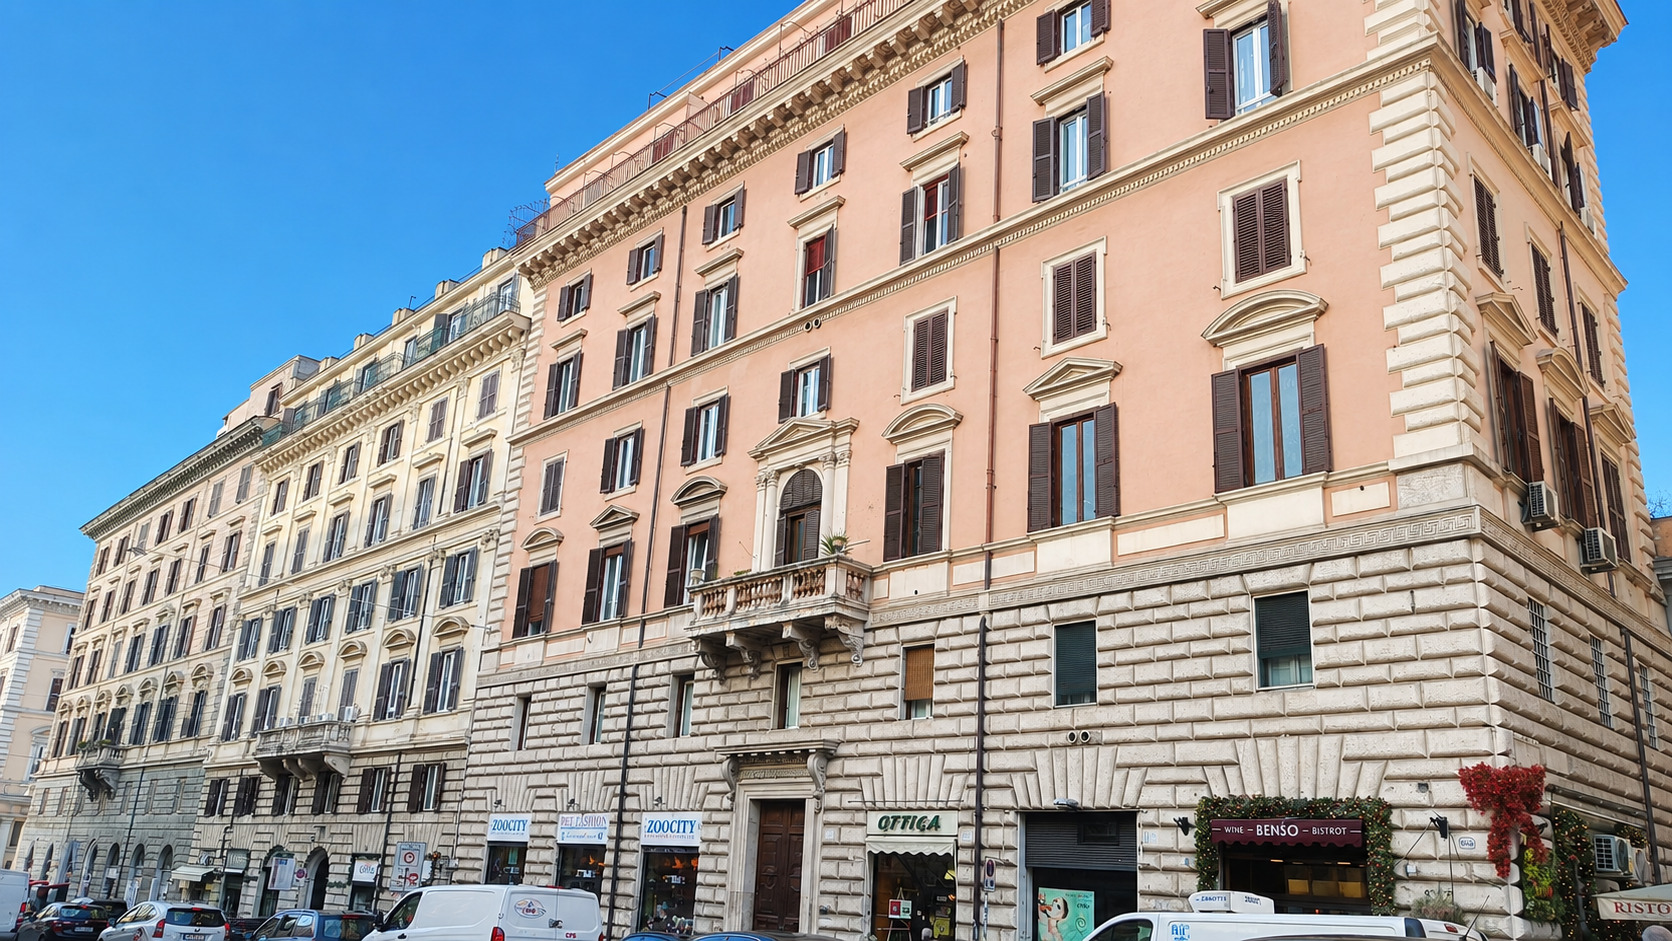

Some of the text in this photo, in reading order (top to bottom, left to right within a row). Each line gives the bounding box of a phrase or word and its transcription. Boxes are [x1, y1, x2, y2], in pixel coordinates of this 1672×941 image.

[492, 819, 528, 832] ZOOCITY
[647, 819, 697, 834] ZOOCITY
[1224, 826, 1244, 834] WINE
[1312, 827, 1347, 835] BISTROT
